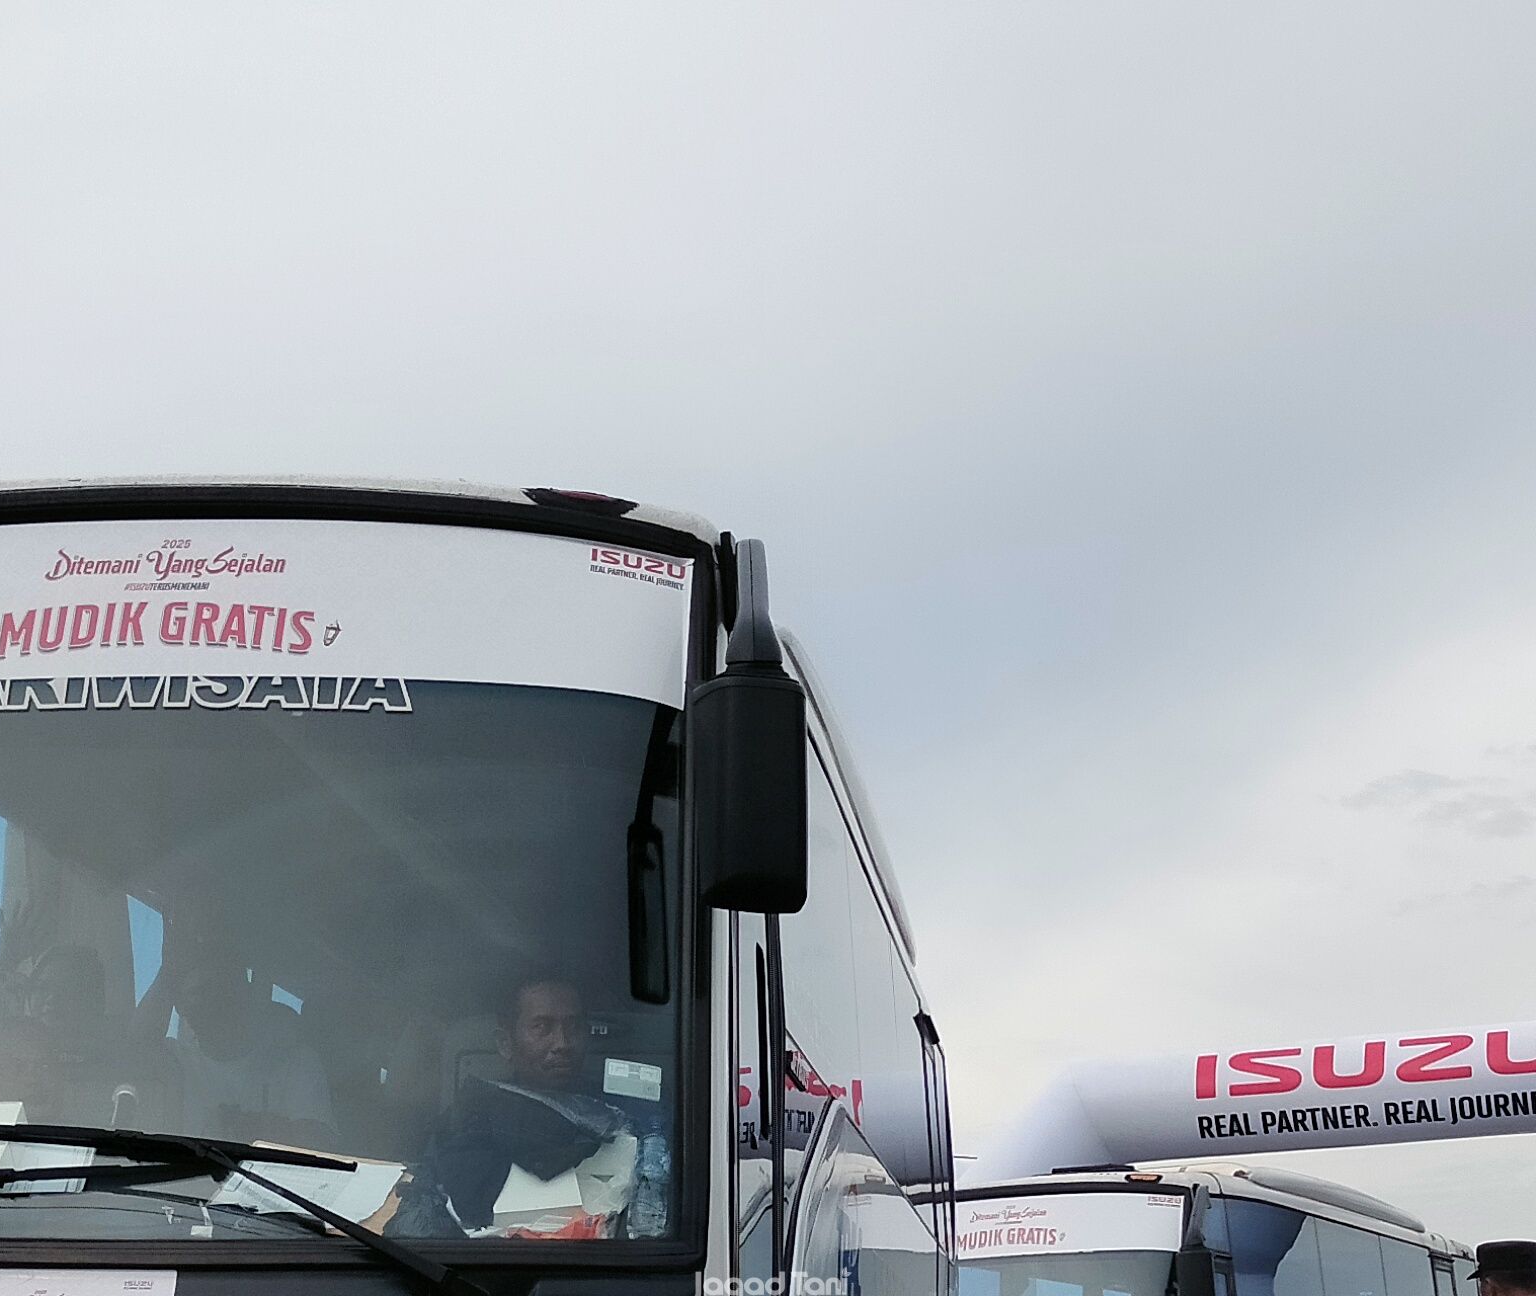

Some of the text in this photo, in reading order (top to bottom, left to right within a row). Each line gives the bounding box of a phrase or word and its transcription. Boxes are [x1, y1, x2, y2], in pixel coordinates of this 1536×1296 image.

[161, 539, 192, 549] 2025
[45, 546, 286, 581] Ditemani Yang Sejalan
[591, 548, 686, 580] ISUZU
[159, 602, 315, 654] GRATIS
[1198, 1112, 1258, 1139] REAL
[1263, 1104, 1378, 1134] PARTNER.
[1384, 1098, 1446, 1126] REAL
[957, 1227, 1058, 1250] MUDIK GRATIS
